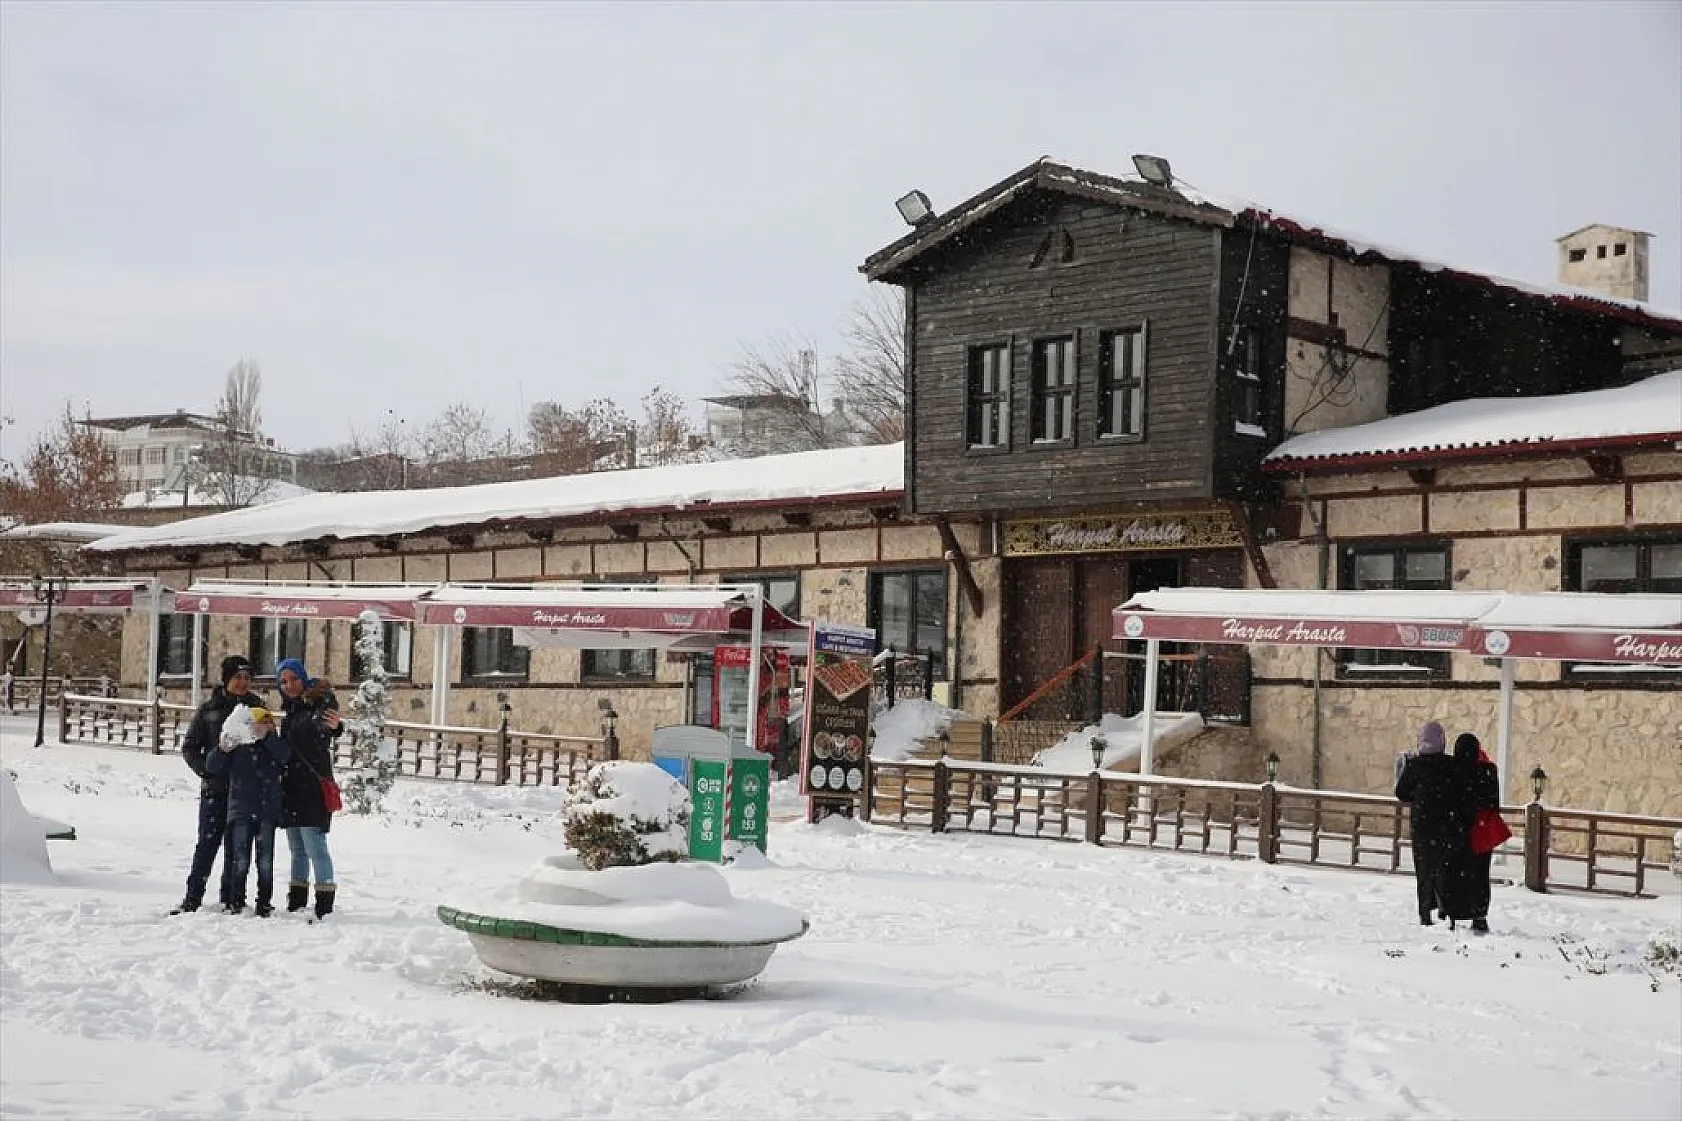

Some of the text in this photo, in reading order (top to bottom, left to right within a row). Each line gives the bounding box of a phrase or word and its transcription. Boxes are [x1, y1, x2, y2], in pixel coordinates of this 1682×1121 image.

[1048, 519, 1185, 548] Harput Arasta
[532, 610, 606, 627] Harput Arasta
[1221, 618, 1347, 644] Harput Arasta
